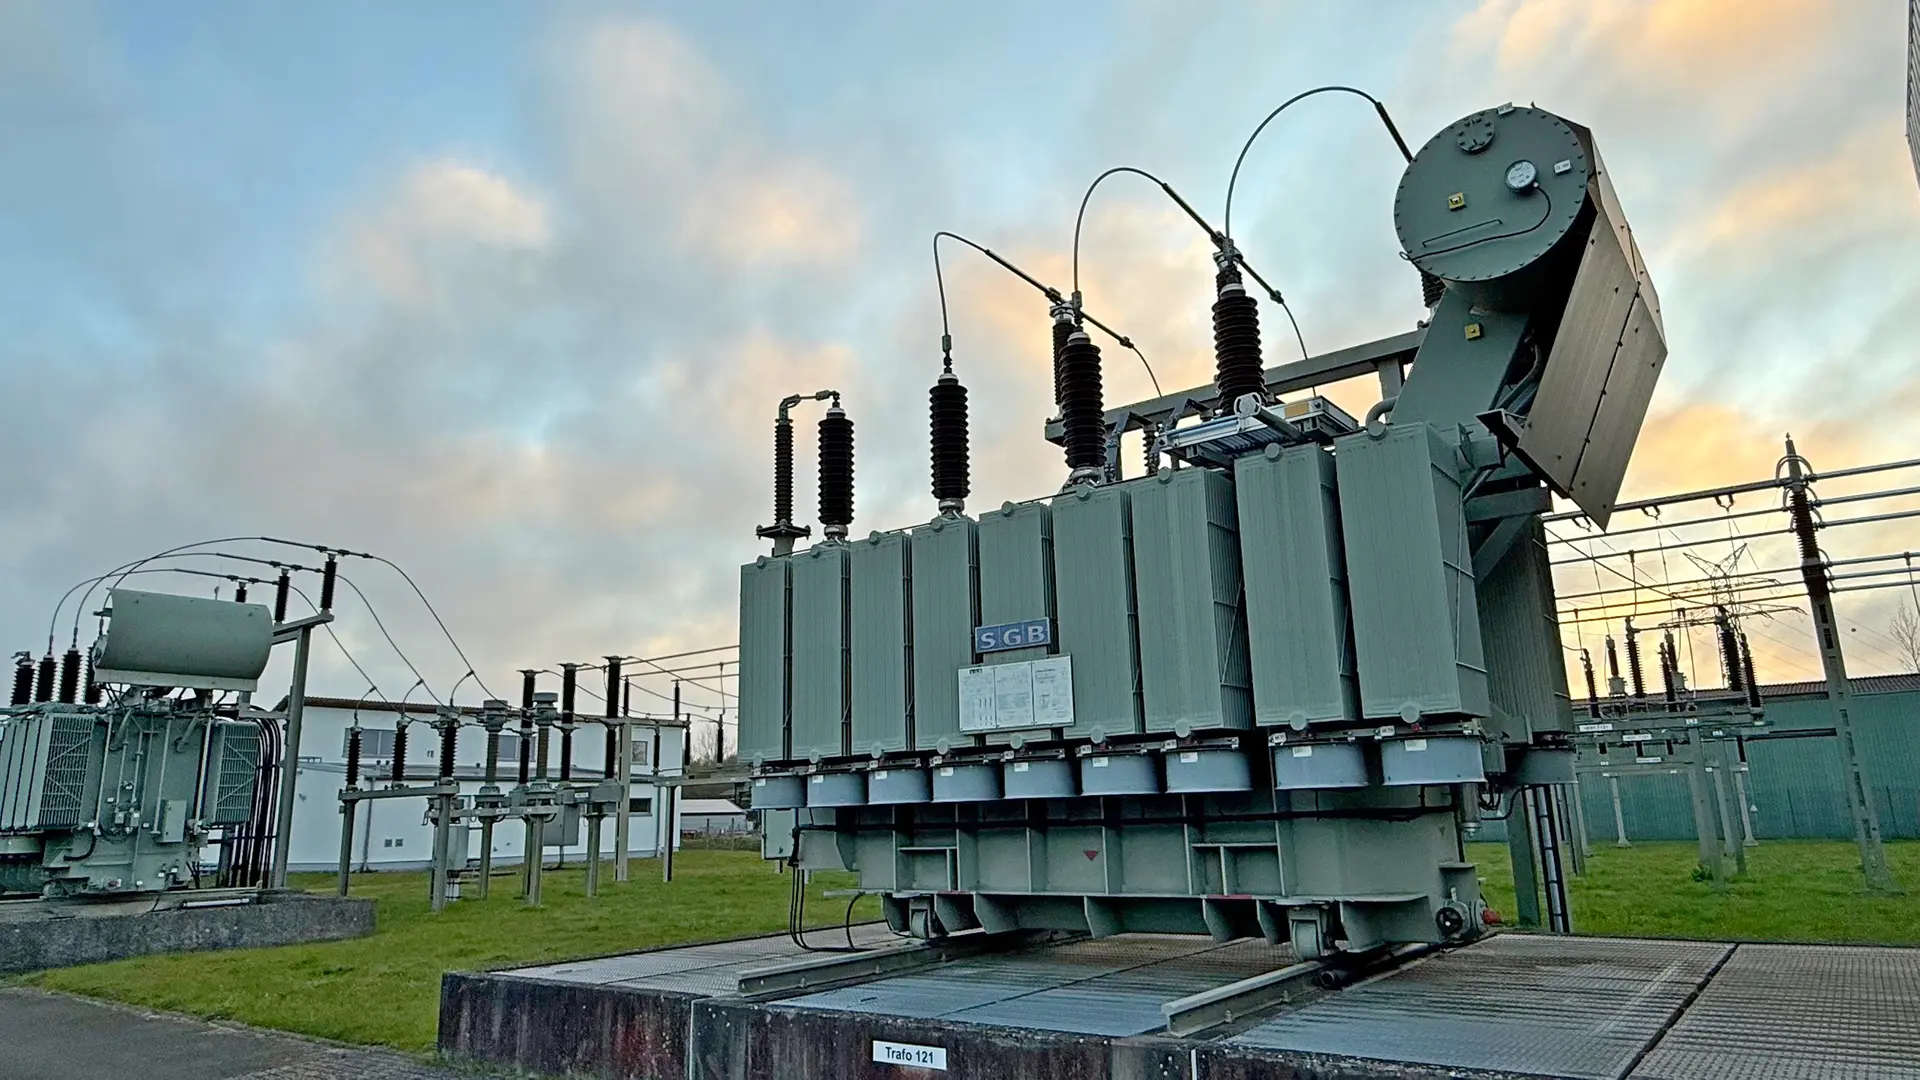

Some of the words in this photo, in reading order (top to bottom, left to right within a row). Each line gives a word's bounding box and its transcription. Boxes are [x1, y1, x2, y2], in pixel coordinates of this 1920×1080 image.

[980, 625, 1045, 649] SGB
[885, 1046, 912, 1061] Trafo
[916, 1050, 933, 1064] 121
